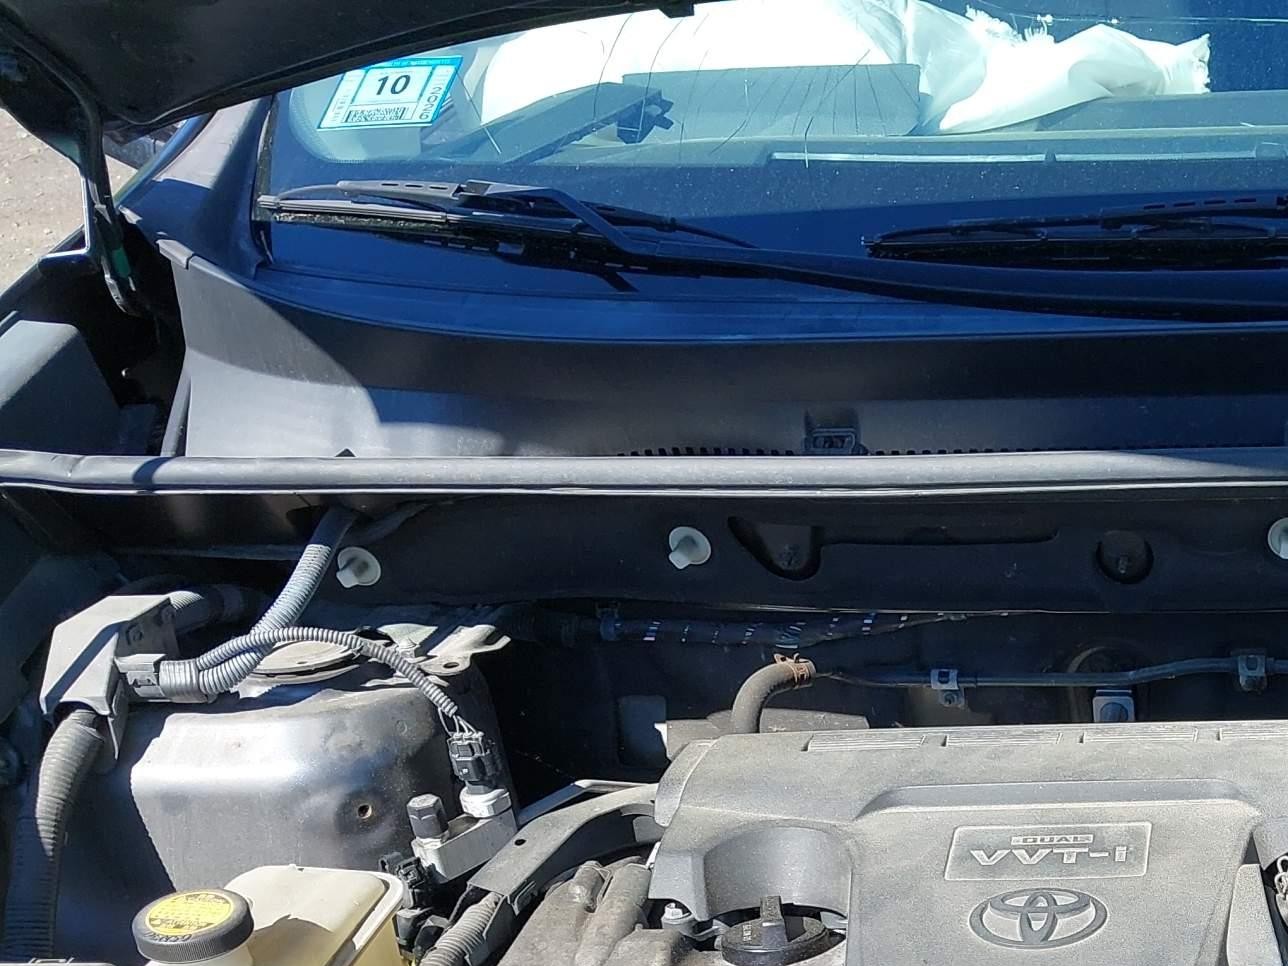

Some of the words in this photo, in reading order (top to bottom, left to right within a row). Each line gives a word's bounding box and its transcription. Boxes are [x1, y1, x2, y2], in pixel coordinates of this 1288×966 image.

[376, 74, 411, 96] 10
[419, 86, 442, 120] 2026
[1022, 835, 1091, 844] DUAL
